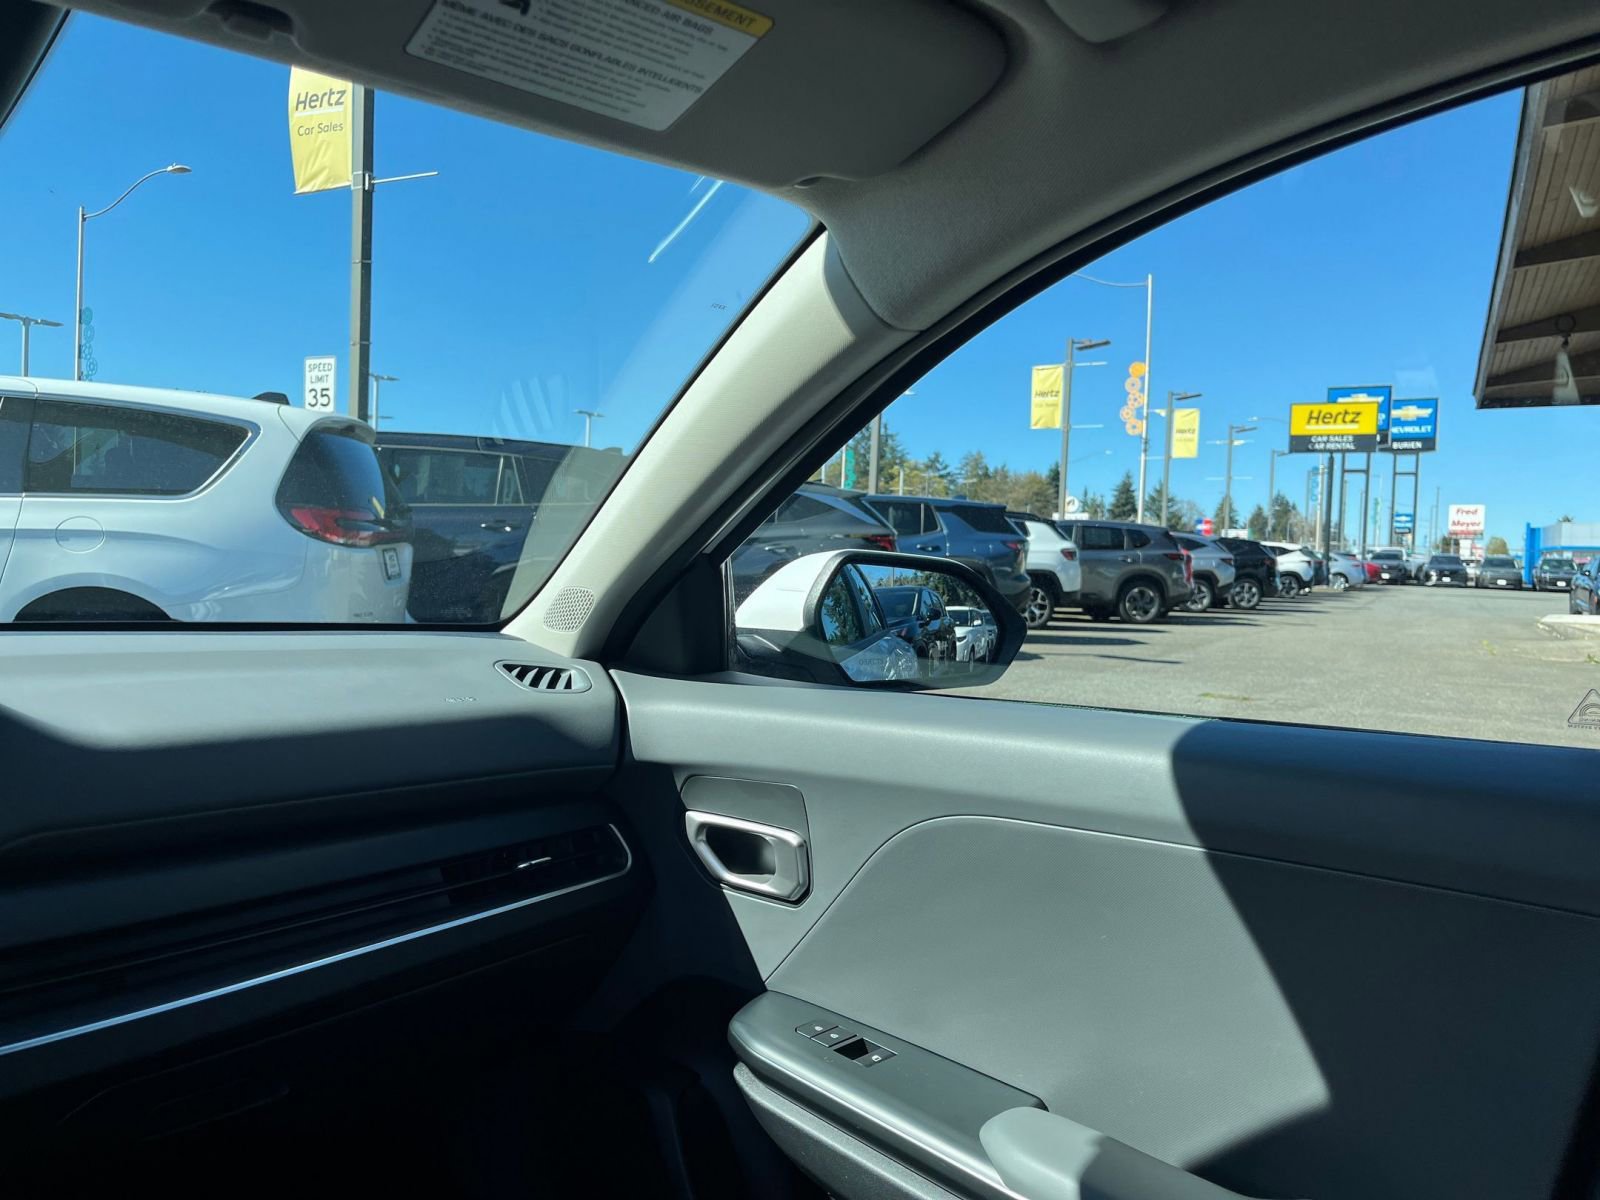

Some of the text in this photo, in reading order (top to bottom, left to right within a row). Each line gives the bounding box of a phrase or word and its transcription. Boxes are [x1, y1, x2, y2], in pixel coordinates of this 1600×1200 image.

[682, 16, 715, 36] BAGS
[295, 88, 347, 112] Hertz
[297, 121, 344, 137] Car Sales
[308, 361, 333, 373] SPEED
[310, 374, 329, 384] LIMIT
[308, 388, 331, 407] 35
[1034, 389, 1060, 398] Hertz
[1306, 409, 1362, 425] Hertz
[1308, 442, 1356, 450] CAR RENTAL
[1392, 441, 1422, 450] BURIEN
[1456, 508, 1478, 516] Fred
[1451, 519, 1481, 530] Meyer
